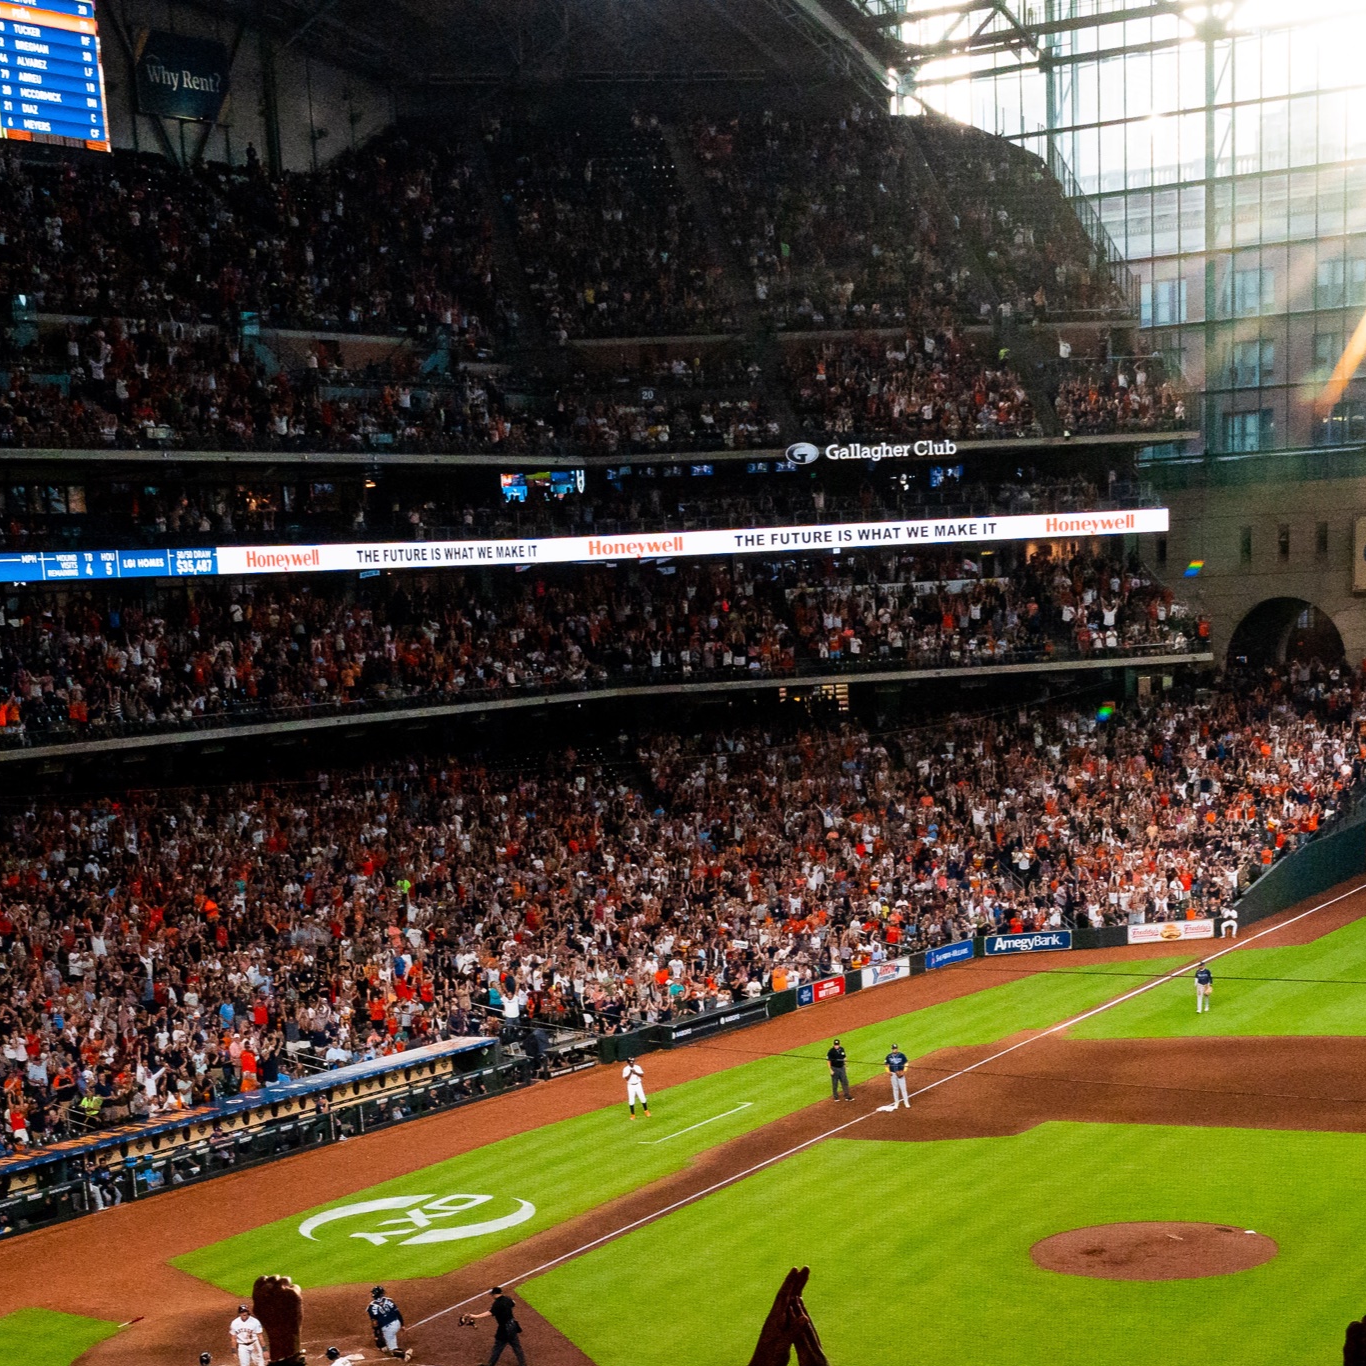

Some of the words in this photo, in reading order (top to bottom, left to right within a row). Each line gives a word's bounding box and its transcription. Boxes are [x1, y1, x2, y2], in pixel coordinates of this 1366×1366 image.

[13, 23, 41, 38] TUCKER
[146, 64, 179, 91] Why
[182, 70, 221, 93] Rent?
[825, 443, 911, 462] Gallagher
[914, 440, 957, 456] Club
[1046, 514, 1135, 535] Honeywell
[734, 535, 766, 548] THE
[770, 531, 833, 546] FUTURE
[837, 530, 852, 542] IS
[858, 527, 901, 541] WHAT
[905, 525, 929, 539] WE
[934, 524, 978, 538] MAKE
[982, 522, 997, 536] IT
[193, 550, 211, 559] DRAW
[356, 550, 381, 564] THE
[383, 548, 429, 563] FUTURE
[431, 548, 442, 560] IS
[444, 547, 475, 561] WHAT
[477, 546, 494, 559] WE
[496, 545, 524, 558] MAKE
[526, 545, 537, 558] IT
[589, 536, 684, 559] Honeywell
[21, 555, 37, 564] MPH
[101, 553, 115, 562] HOU
[137, 557, 165, 568] HOMES
[246, 549, 321, 571] Honeywell
[1131, 925, 1160, 940] Freddy's
[1184, 920, 1212, 936] Freddy's
[993, 931, 1064, 953] AmegyBank
